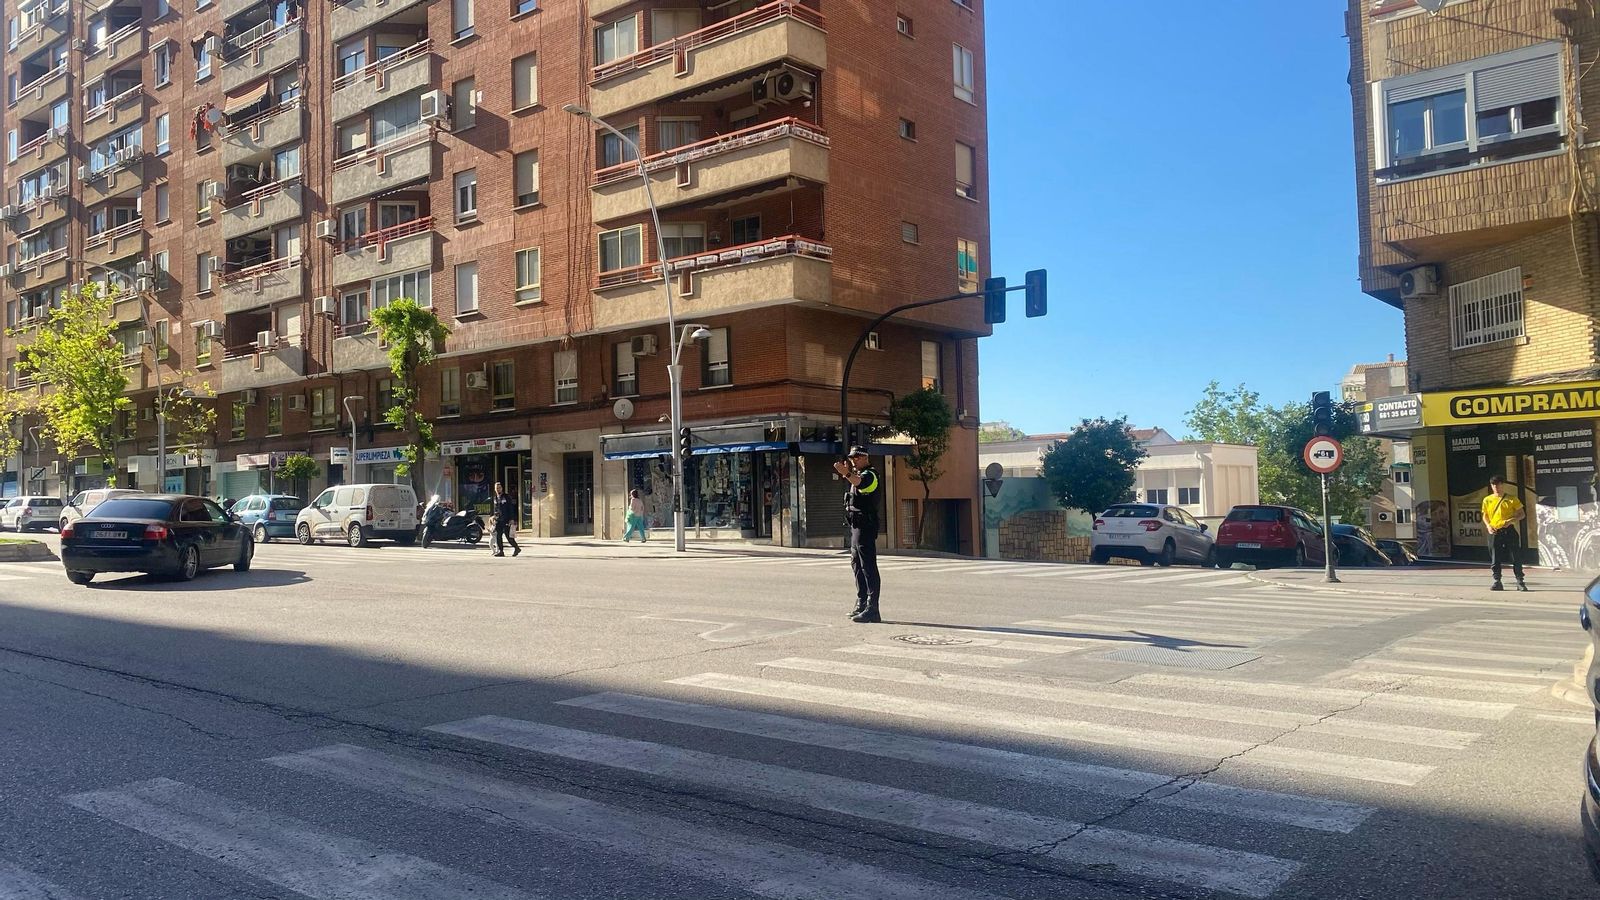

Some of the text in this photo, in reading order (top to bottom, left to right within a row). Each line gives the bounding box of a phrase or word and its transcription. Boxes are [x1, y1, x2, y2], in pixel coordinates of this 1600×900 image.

[1378, 400, 1417, 411] CONTACTO
[1456, 391, 1600, 416] COMPRAM
[1391, 410, 1399, 418] 35
[1400, 409, 1408, 417] 64
[1510, 432, 1519, 440] 35
[1542, 431, 1562, 439] HACEN
[1452, 437, 1480, 446] MAXIMA
[1458, 510, 1482, 524] ORO
[1459, 528, 1483, 537] PLATA
